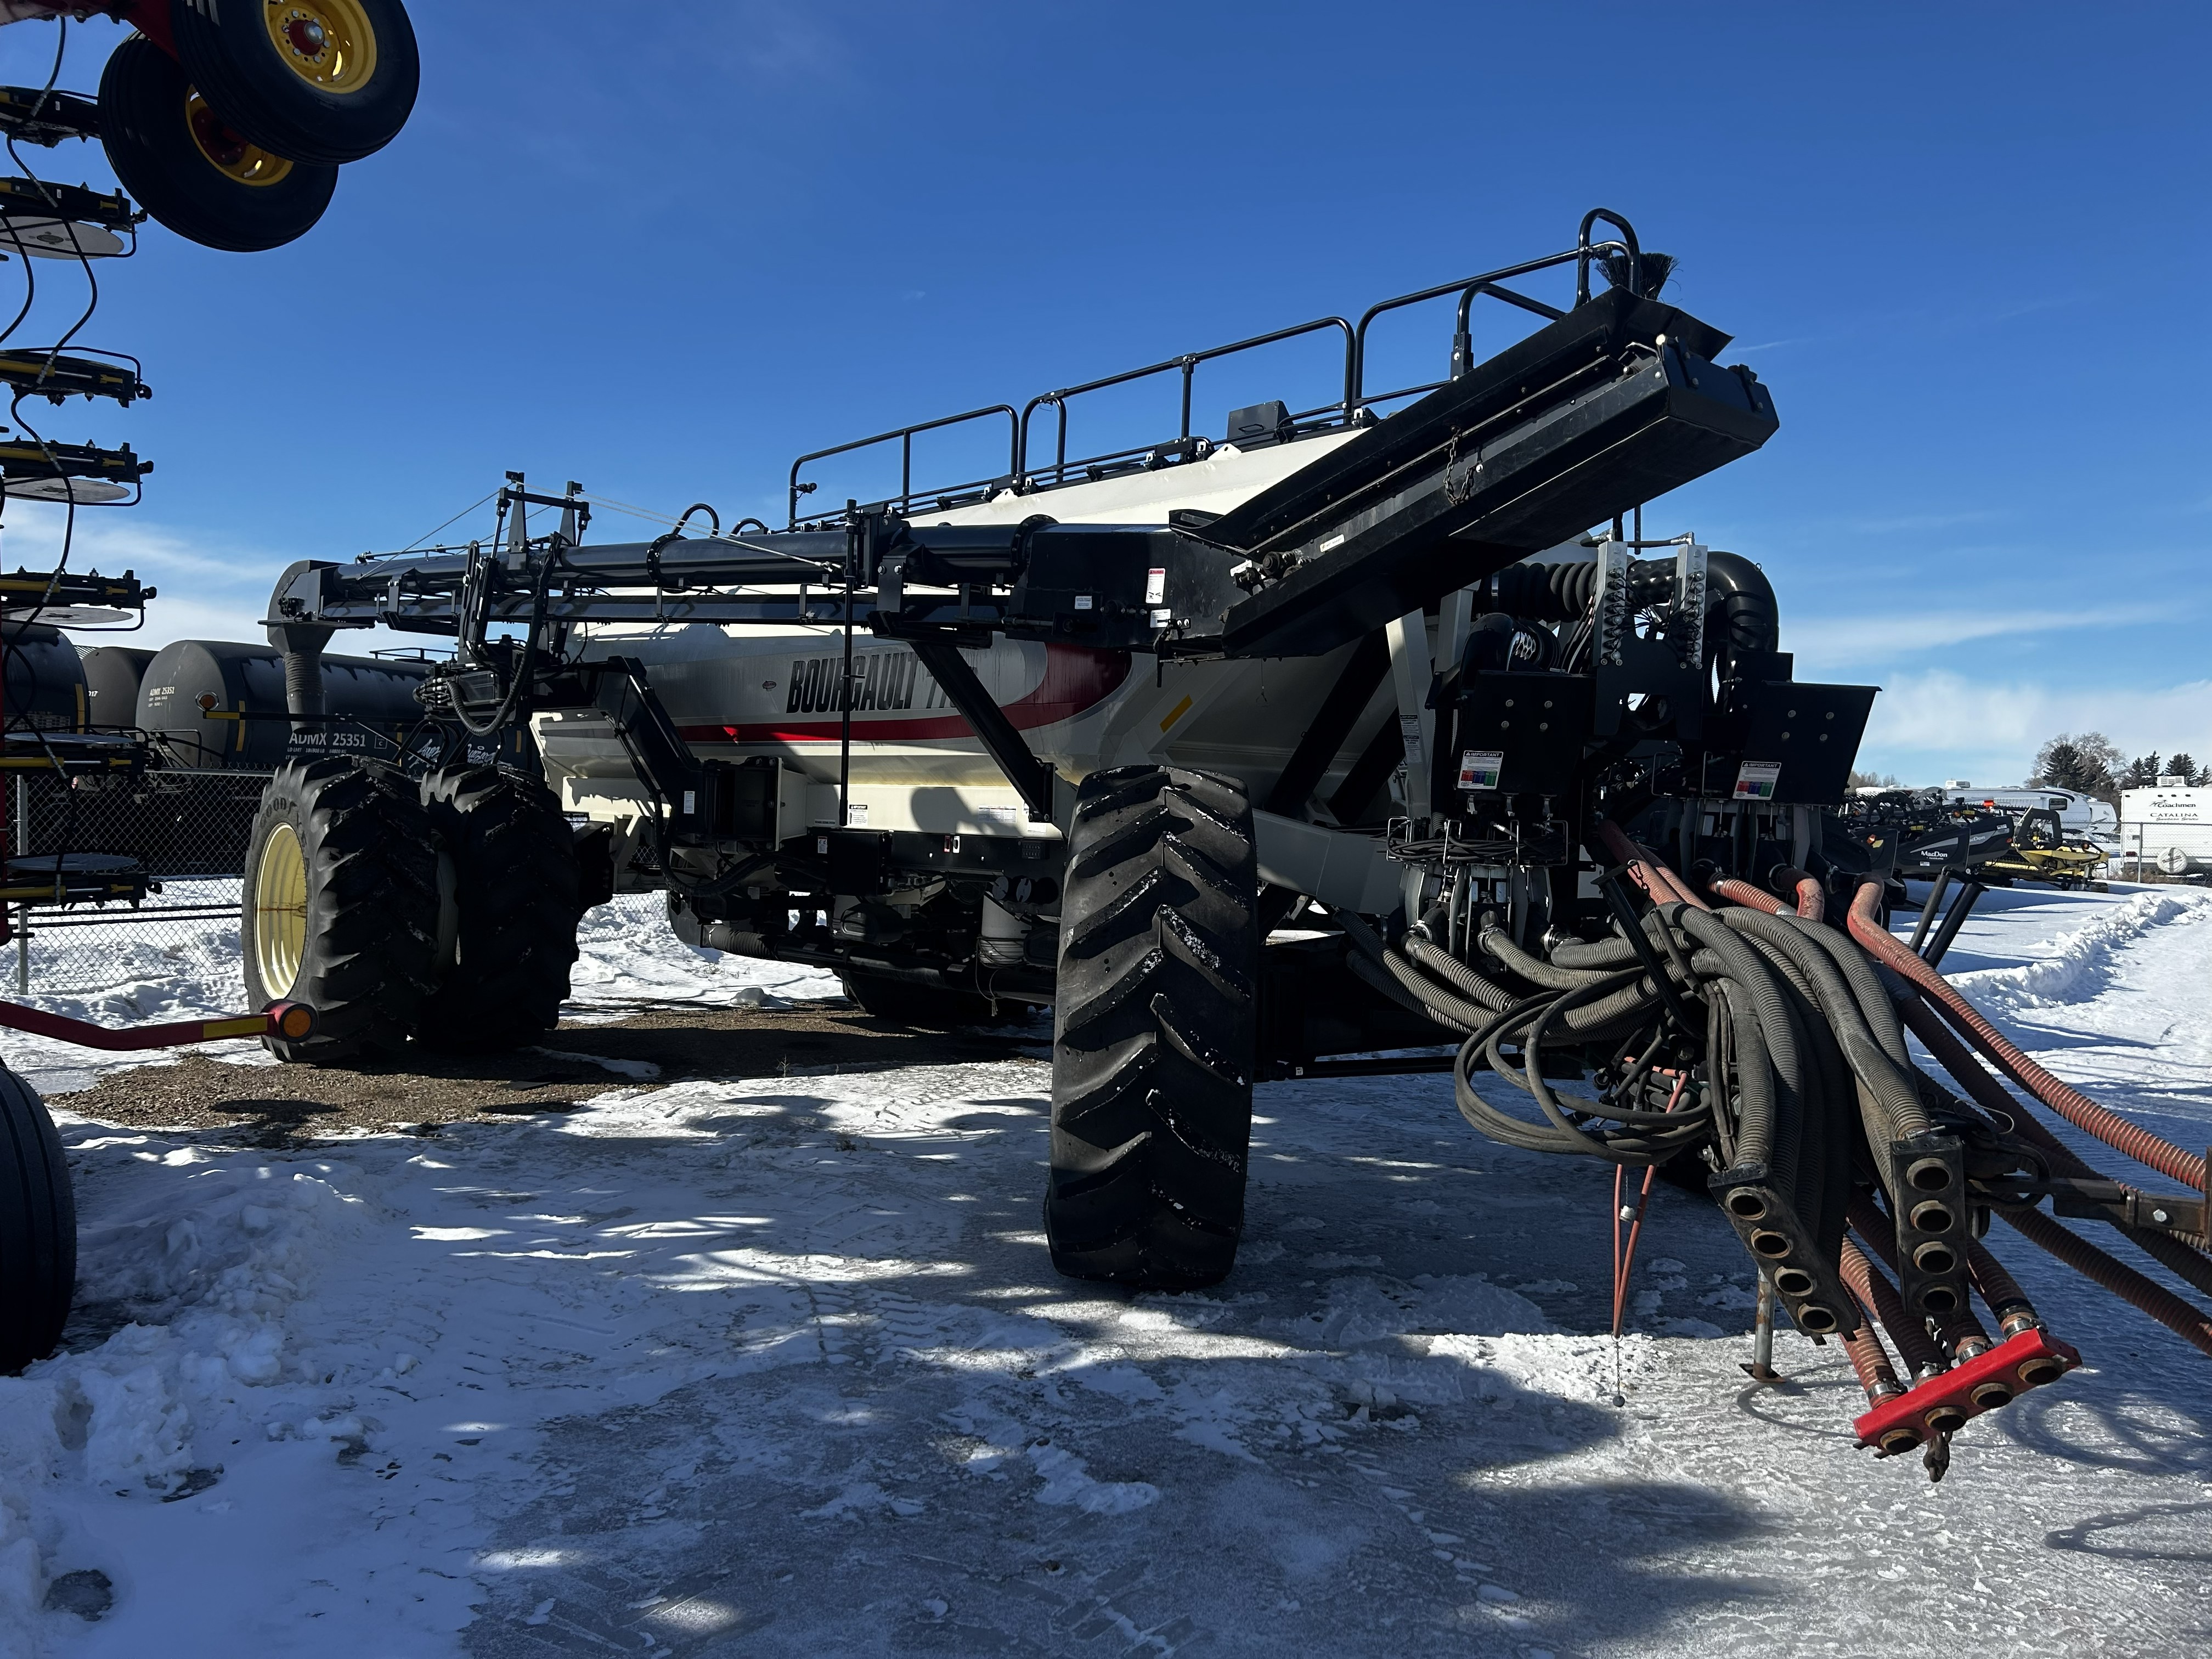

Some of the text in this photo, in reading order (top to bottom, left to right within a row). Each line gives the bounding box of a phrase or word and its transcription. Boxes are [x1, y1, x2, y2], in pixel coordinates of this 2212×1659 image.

[786, 652, 919, 713] BOURGAULT
[161, 686, 175, 695] 25351
[289, 732, 366, 747] ADMX 25351
